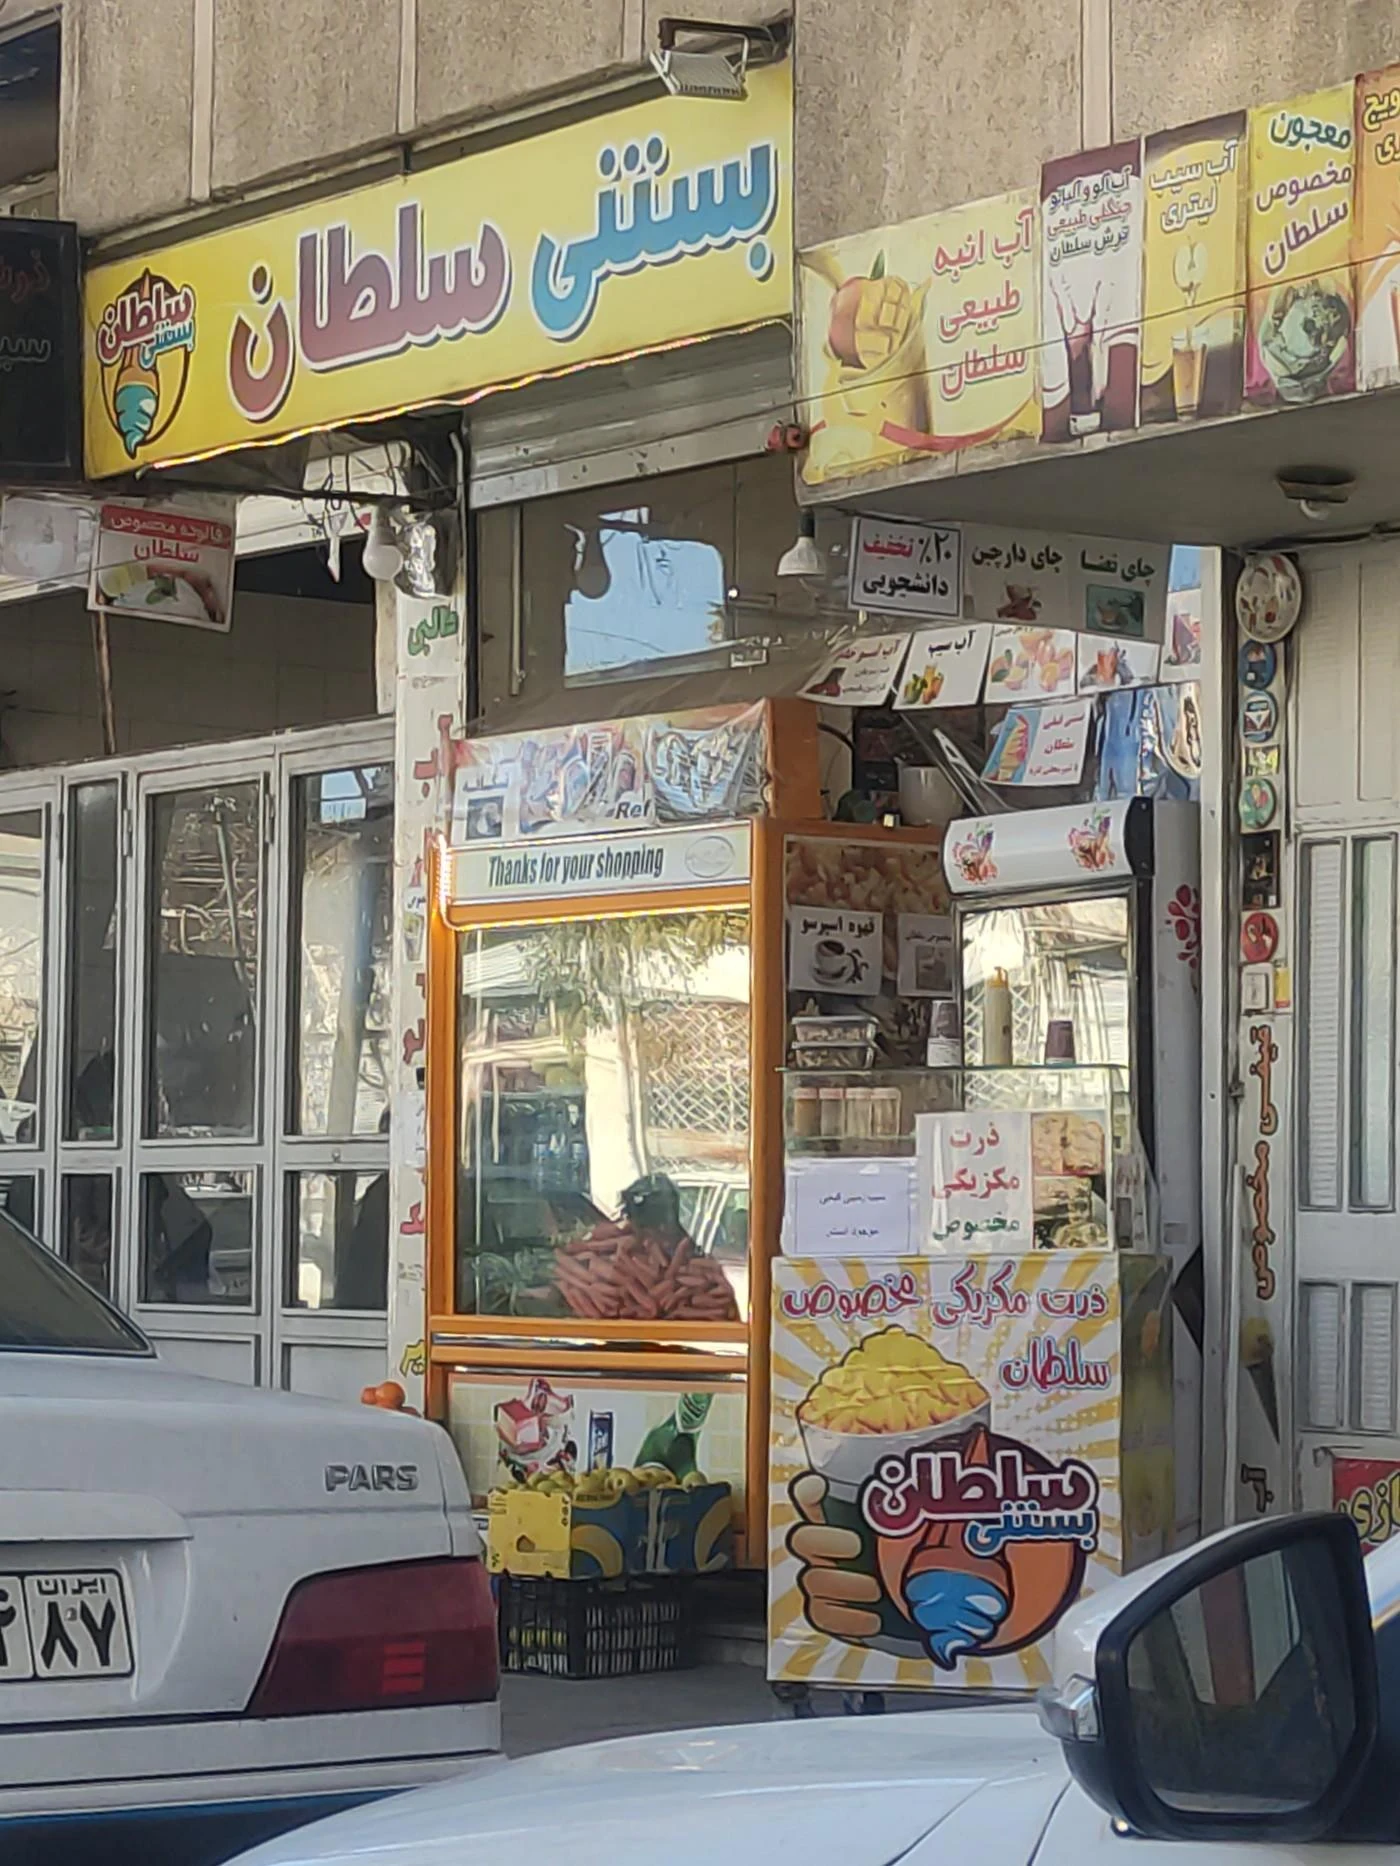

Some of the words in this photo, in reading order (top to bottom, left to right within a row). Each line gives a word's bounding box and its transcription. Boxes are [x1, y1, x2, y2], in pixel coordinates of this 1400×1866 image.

[1271, 113, 1351, 151] معجون
[1362, 88, 1400, 133] ویج
[1149, 162, 1202, 198] سیب
[1207, 140, 1238, 182] آب
[1160, 181, 1217, 232] لیتری
[1255, 161, 1351, 211] مخصوص
[531, 136, 778, 342] بستنی
[934, 229, 985, 281] انبه
[992, 207, 1035, 267] آب
[1264, 202, 1348, 275] سلطان
[97, 282, 195, 365] سلطان
[227, 200, 513, 422] سلطان
[940, 279, 1021, 341] طبیعی
[140, 318, 195, 369] بستنی
[941, 344, 1027, 400] سلطان
[134, 538, 199, 563] سلطان
[863, 532, 914, 559] تخفیف
[863, 571, 949, 598] دانشجویی
[1121, 556, 1155, 586] چای
[488, 851, 537, 888] Thanks
[538, 851, 561, 883] for
[562, 853, 595, 884] your
[596, 844, 665, 880] shopping
[848, 916, 876, 938] قهوه
[950, 1121, 1000, 1155] ذرت
[931, 1167, 1020, 1199] مکزیکی
[933, 1211, 1020, 1241] مخصوص
[782, 1271, 923, 1319] مخصوص
[931, 1260, 1030, 1329] مکزیکی
[1038, 1284, 1108, 1318] ذرت
[1001, 1336, 1111, 1391] سلطان
[325, 1465, 418, 1491] PARS
[862, 1449, 1096, 1537] سلطان
[964, 1500, 1097, 1556] بستنی
[37, 1577, 106, 1595] ایران
[41, 1598, 116, 1670] ۸۷
